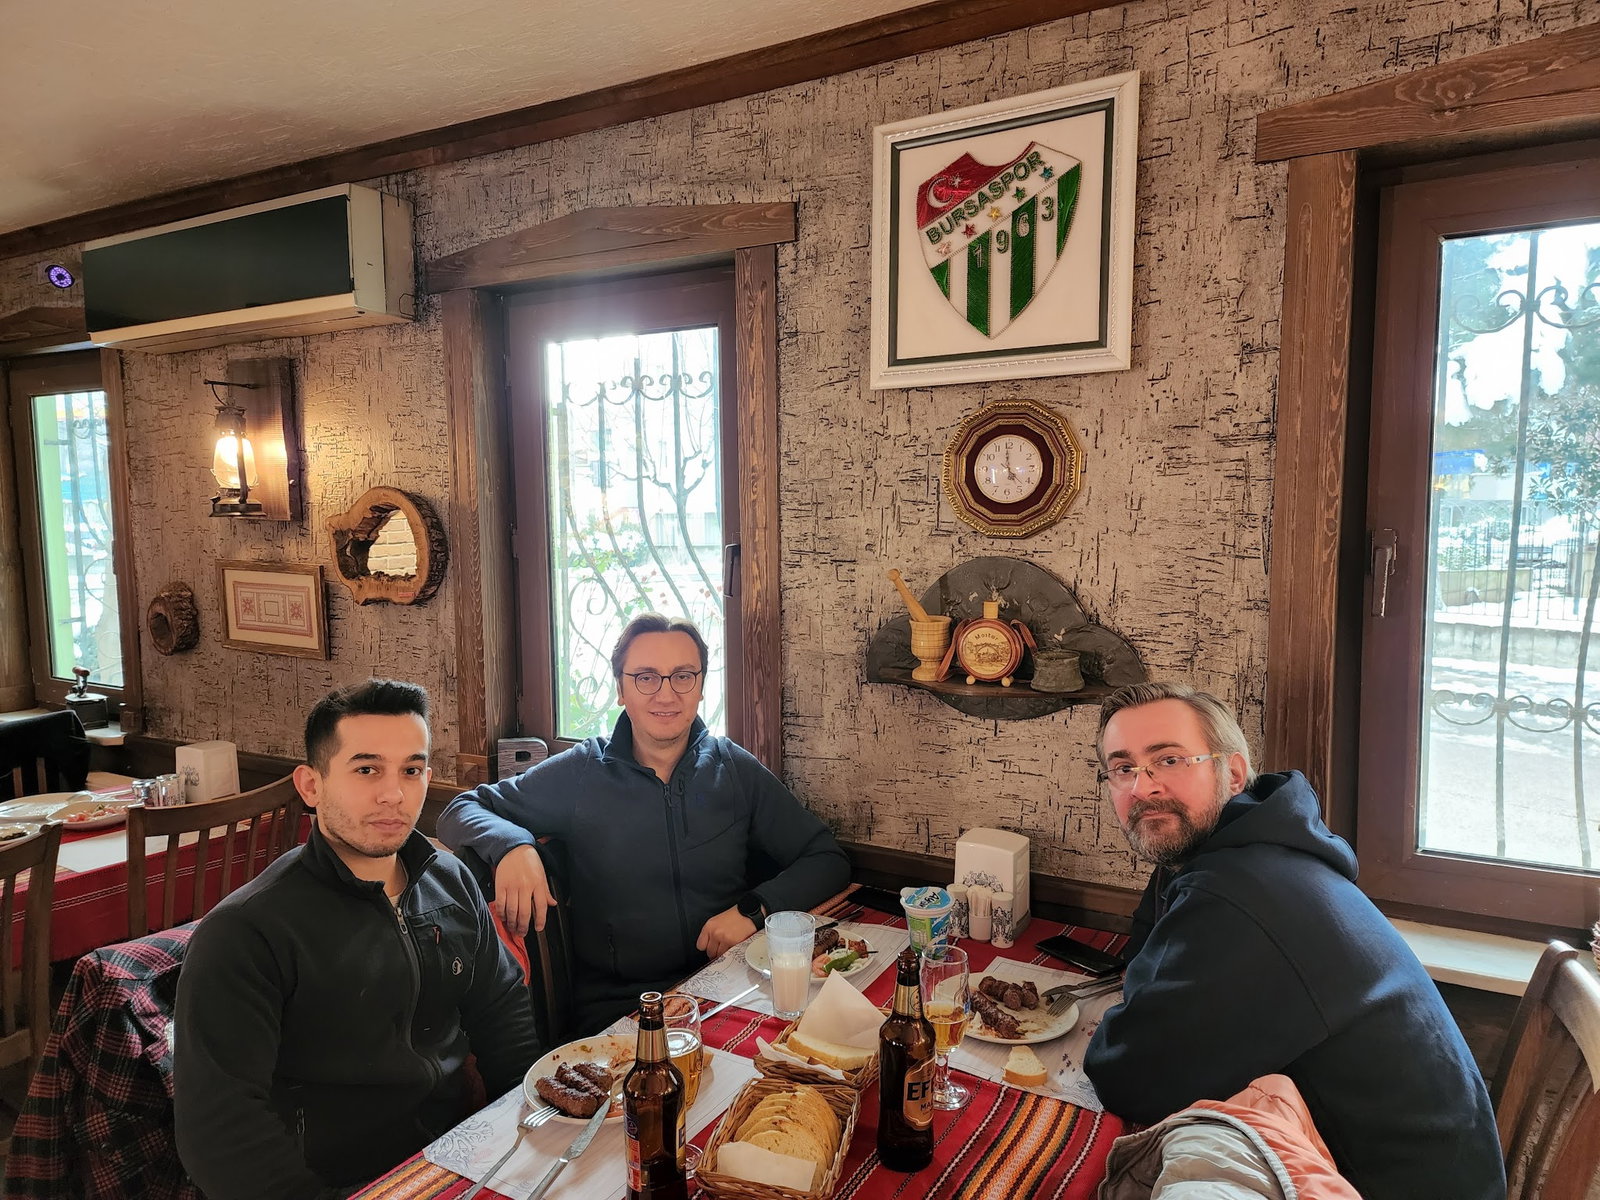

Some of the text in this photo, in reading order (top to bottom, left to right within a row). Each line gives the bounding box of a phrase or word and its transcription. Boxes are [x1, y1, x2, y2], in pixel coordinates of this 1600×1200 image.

[926, 150, 1045, 245] BURSASPOR
[974, 196, 1054, 268] 1963
[1005, 441, 1013, 449] 12
[986, 453, 995, 461] 10
[984, 476, 991, 484] 8
[1016, 485, 1023, 493] 5
